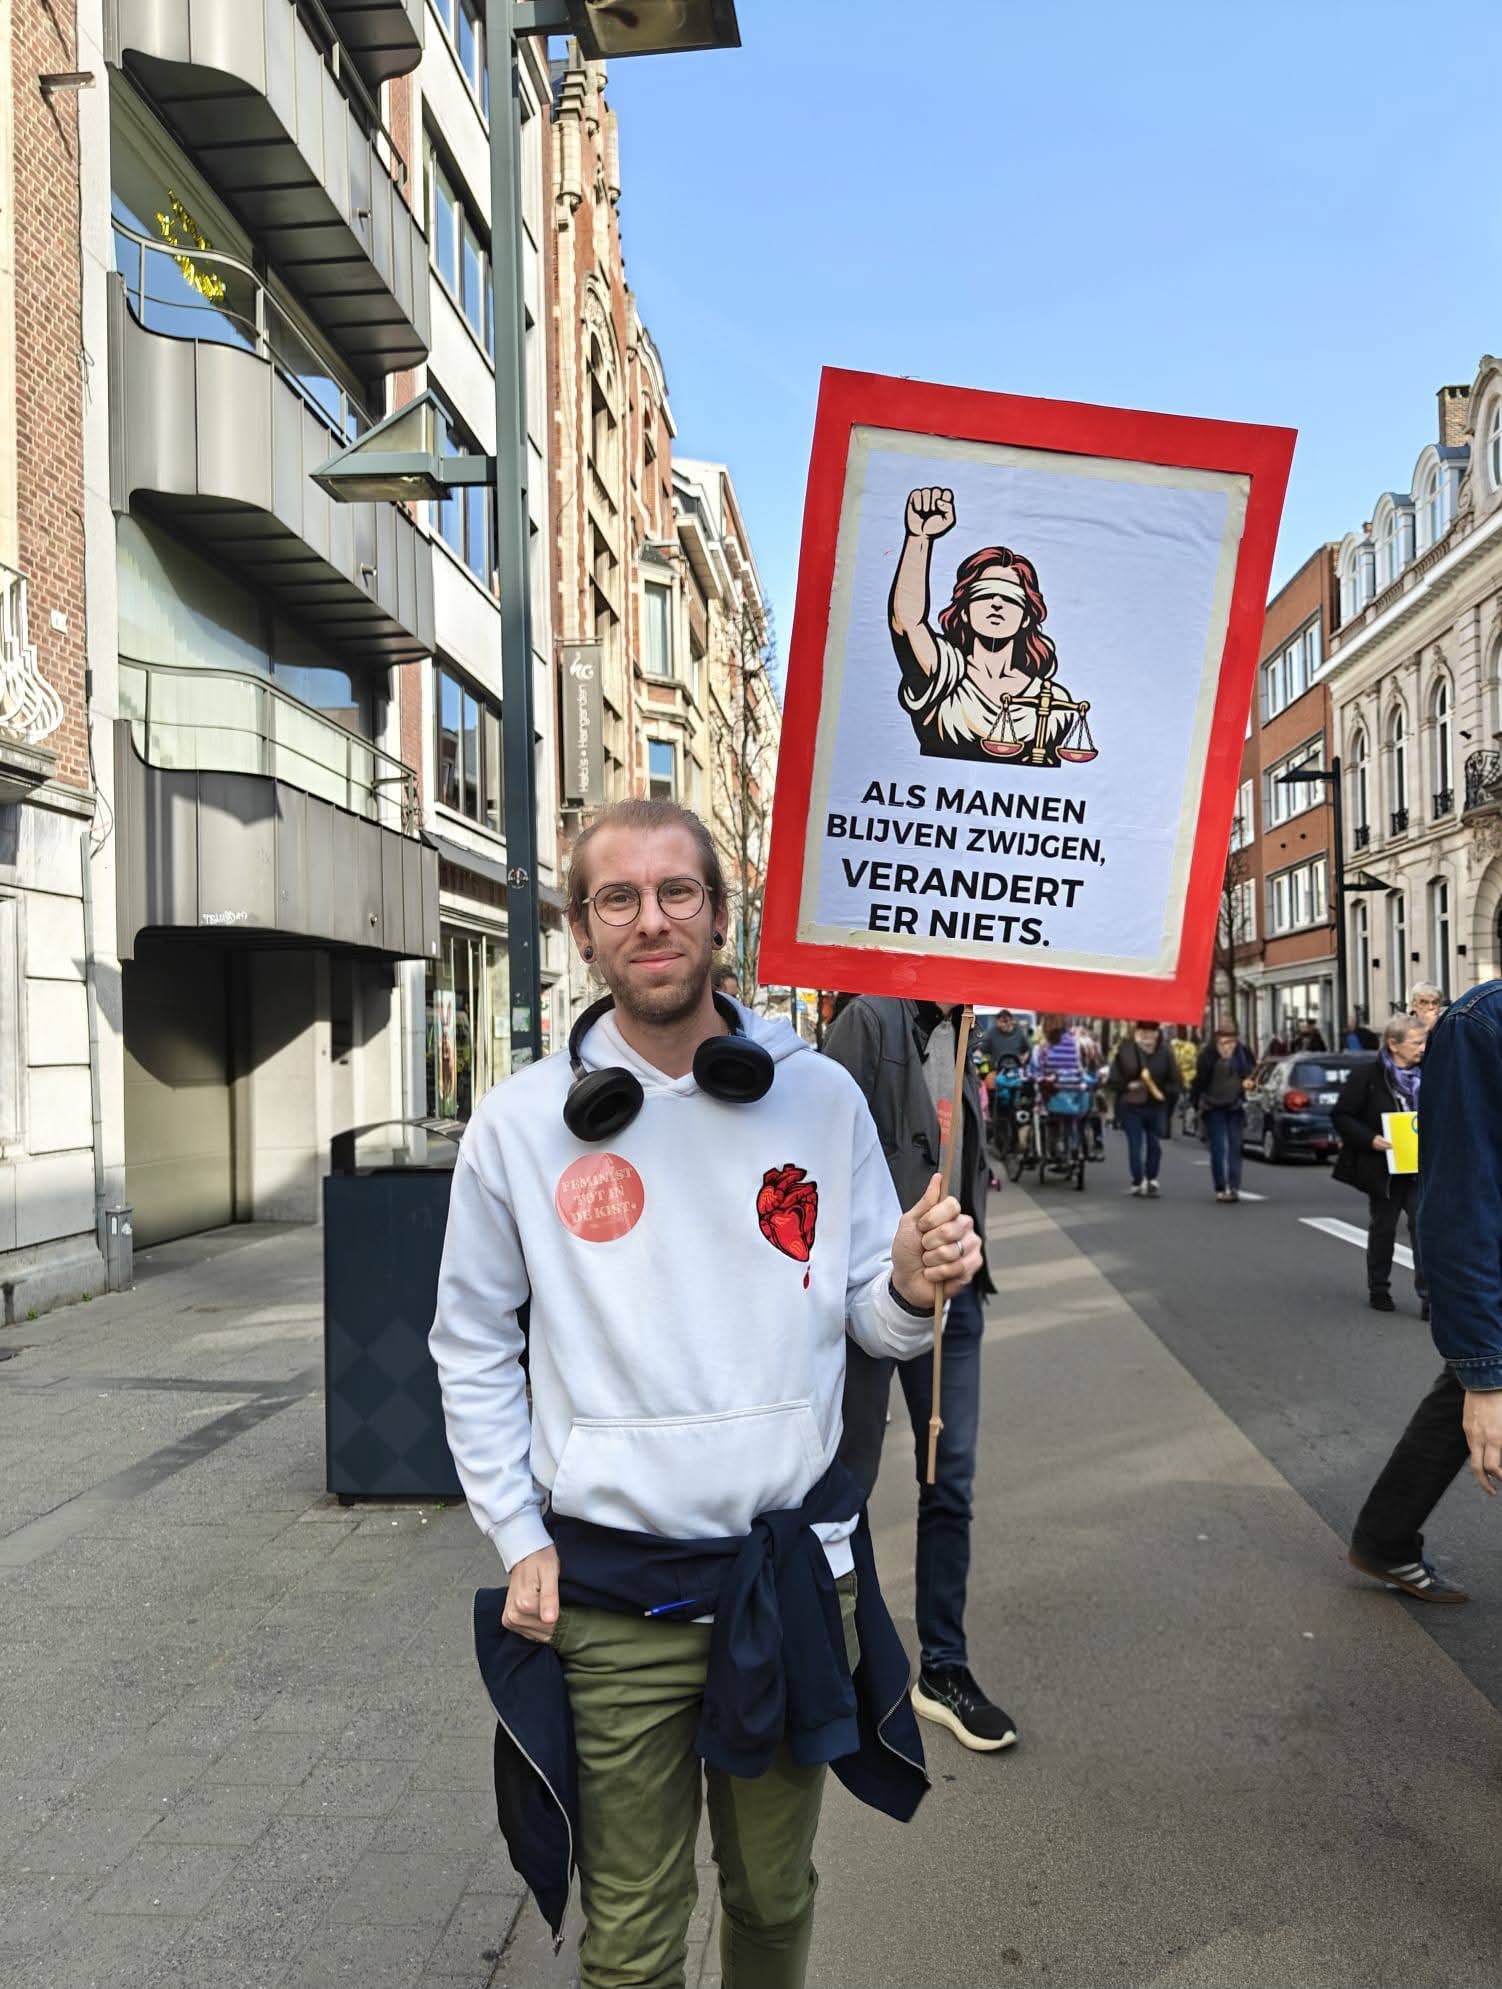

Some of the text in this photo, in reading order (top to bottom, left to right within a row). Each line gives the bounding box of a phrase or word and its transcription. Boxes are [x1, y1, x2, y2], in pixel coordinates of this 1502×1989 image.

[860, 781, 1086, 824] ALS MANNEN
[827, 813, 1106, 867] BLIJVEN ZWIJGEN,
[841, 858, 1084, 908] VERANDERT
[868, 903, 1050, 947] ER NIETS.
[561, 1167, 633, 1192] FEMINIST
